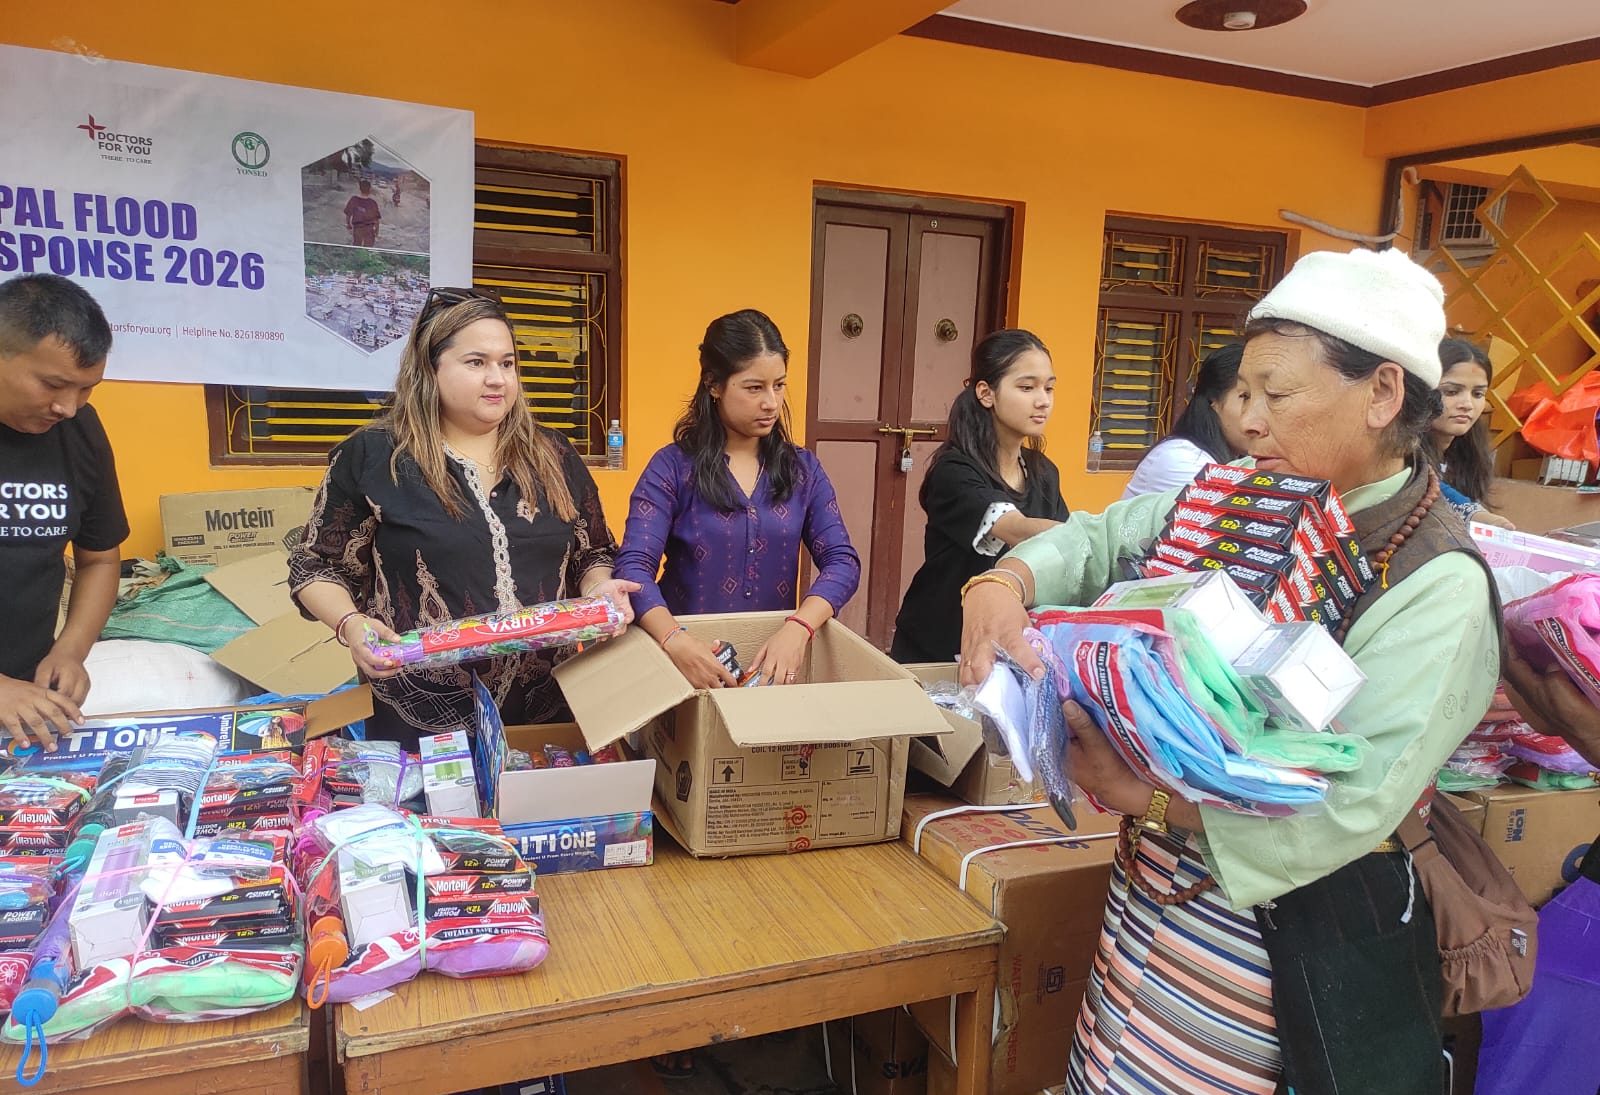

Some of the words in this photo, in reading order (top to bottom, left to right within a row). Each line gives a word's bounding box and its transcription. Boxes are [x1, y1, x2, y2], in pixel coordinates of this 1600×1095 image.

[98, 132, 153, 146] DOCTORS
[98, 142, 122, 152] FOR
[126, 145, 151, 155] YOU
[237, 168, 268, 177] YONSED
[0, 185, 64, 230] PAL
[74, 192, 198, 241] FLOOD
[164, 245, 265, 290] 2026
[183, 327, 217, 338] Helpline
[219, 329, 233, 338] No.
[234, 330, 285, 341] 8261890890
[1209, 467, 1245, 481] Mortein
[0, 482, 68, 499] CTORS
[1190, 487, 1223, 502] Mortein
[14, 503, 66, 520] YOU
[205, 507, 274, 532] Mortein
[1180, 508, 1212, 525] Mortein
[1329, 495, 1348, 532] Mortein
[11, 526, 32, 537] TO
[34, 525, 68, 536] CARE
[1174, 526, 1211, 546] Mortein
[1302, 516, 1324, 552] Mortein
[1159, 544, 1195, 563] Mortein
[1294, 541, 1315, 577] Mortein
[1293, 568, 1312, 604] Mortein
[488, 616, 545, 632] SURYA
[1097, 644, 1112, 707] COMFORTABLE
[44, 731, 107, 753] TI
[856, 751, 864, 766] 7
[18, 812, 52, 823] Mortein
[195, 827, 221, 835] POWE
[15, 836, 50, 846] Mortein
[560, 831, 596, 850] ONE
[436, 880, 468, 891] Mortein
[3, 910, 37, 920] POWER
[494, 902, 526, 914] Mortein
[443, 929, 474, 937] TOTALLY
